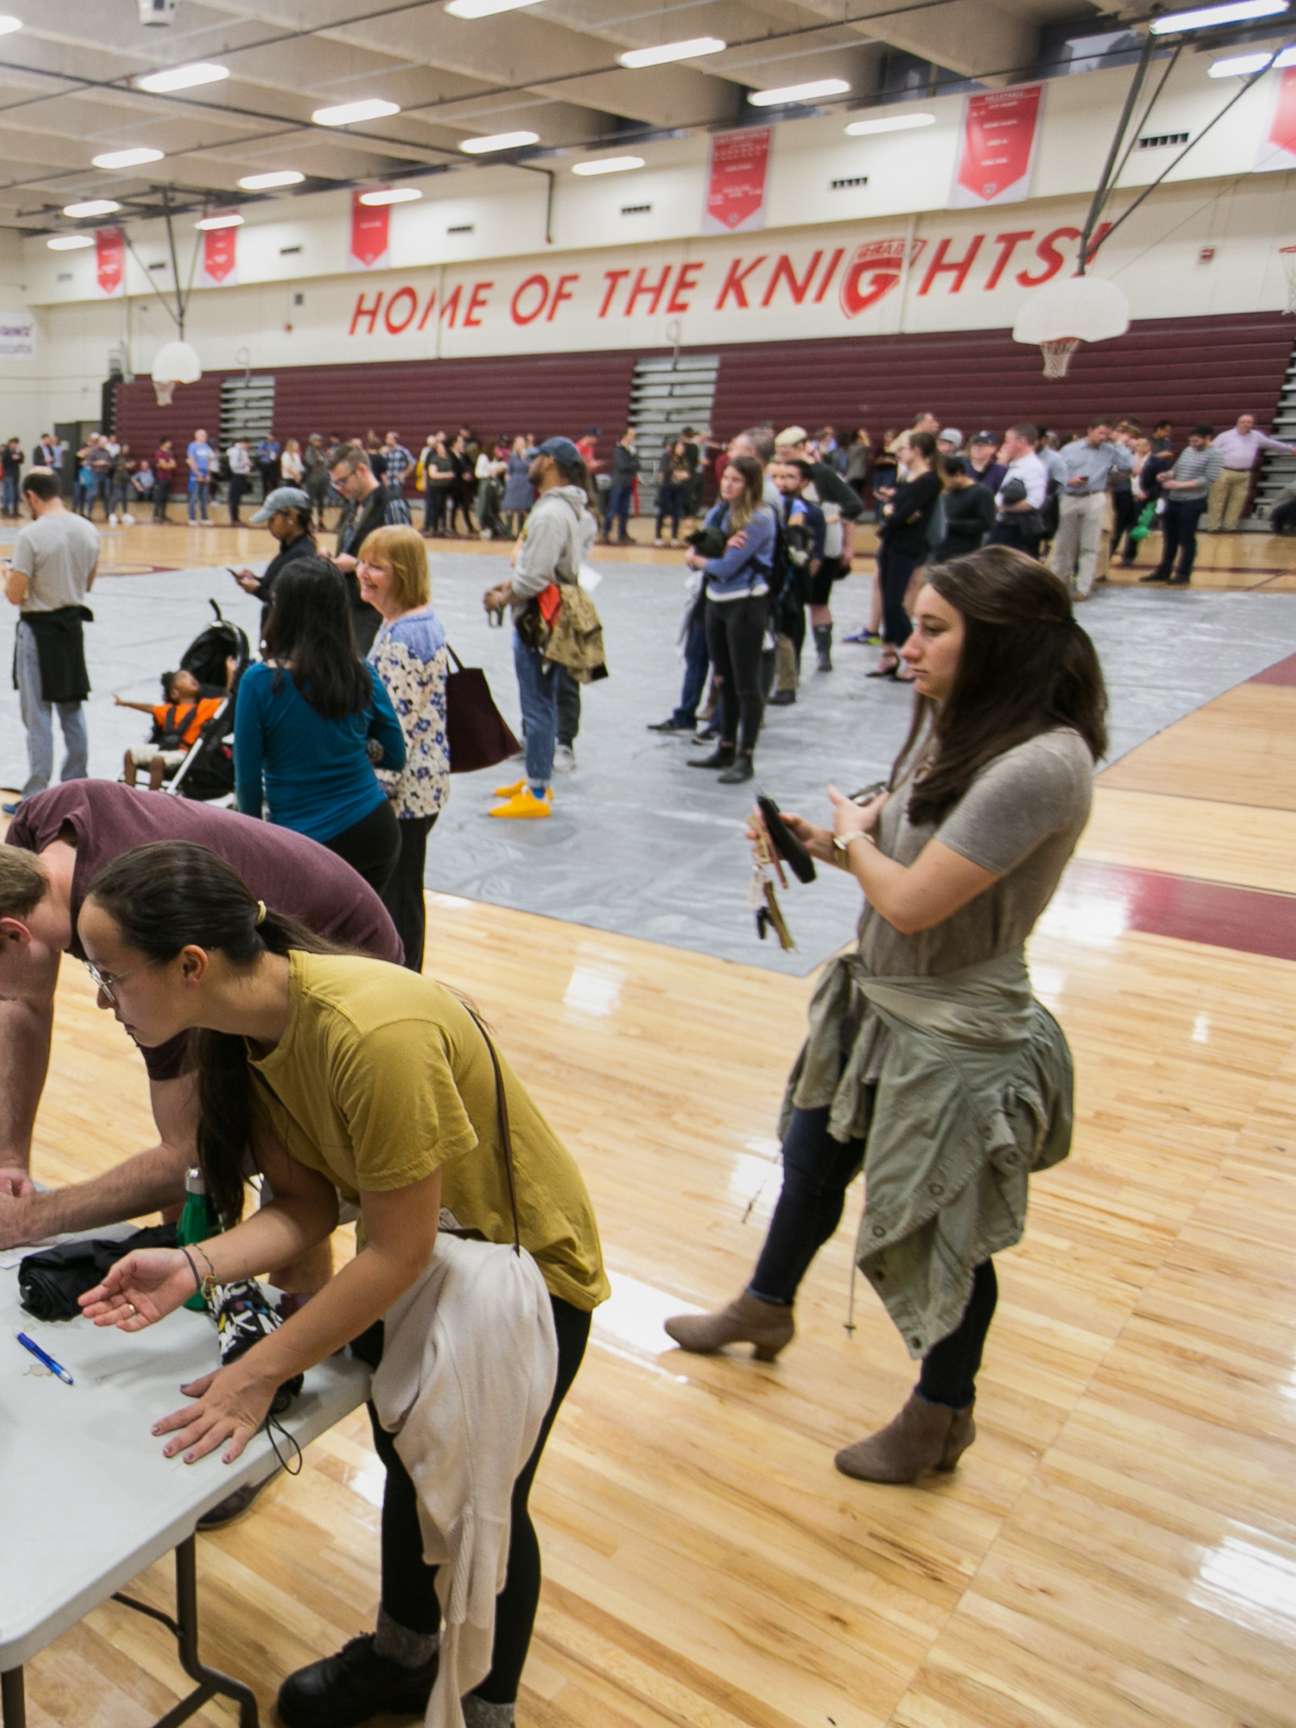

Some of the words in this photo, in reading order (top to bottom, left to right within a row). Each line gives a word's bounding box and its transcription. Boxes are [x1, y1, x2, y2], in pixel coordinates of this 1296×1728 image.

[348, 282, 494, 336] HOME
[509, 273, 580, 326] OF
[597, 261, 706, 318] THE
